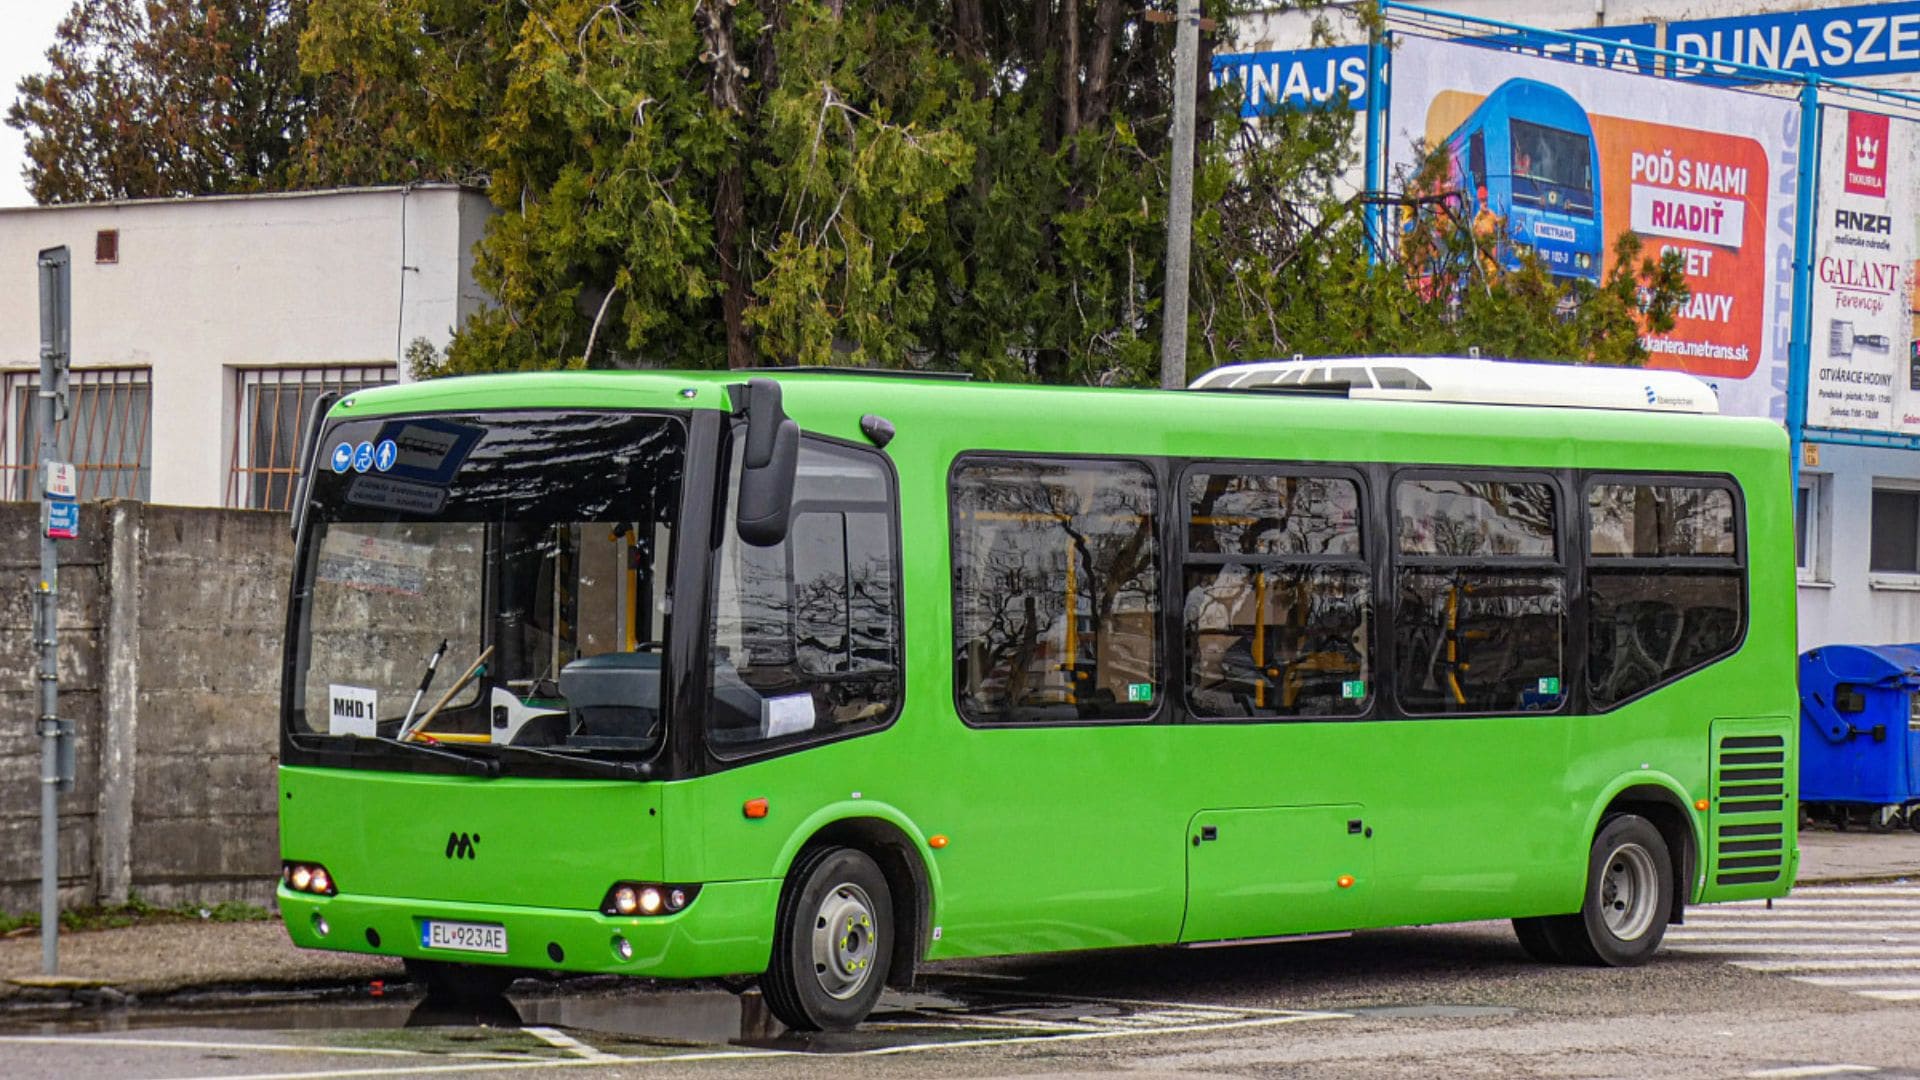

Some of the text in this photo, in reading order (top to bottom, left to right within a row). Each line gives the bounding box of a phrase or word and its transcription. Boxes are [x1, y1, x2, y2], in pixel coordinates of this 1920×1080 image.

[1631, 149, 1747, 195] POĎ S NAMI
[1652, 200, 1724, 235] RIADIŤ
[1835, 209, 1892, 235] ANZA
[1768, 108, 1800, 418] METRANS
[1819, 256, 1900, 291] GALANT
[334, 697, 374, 720] MHD 1
